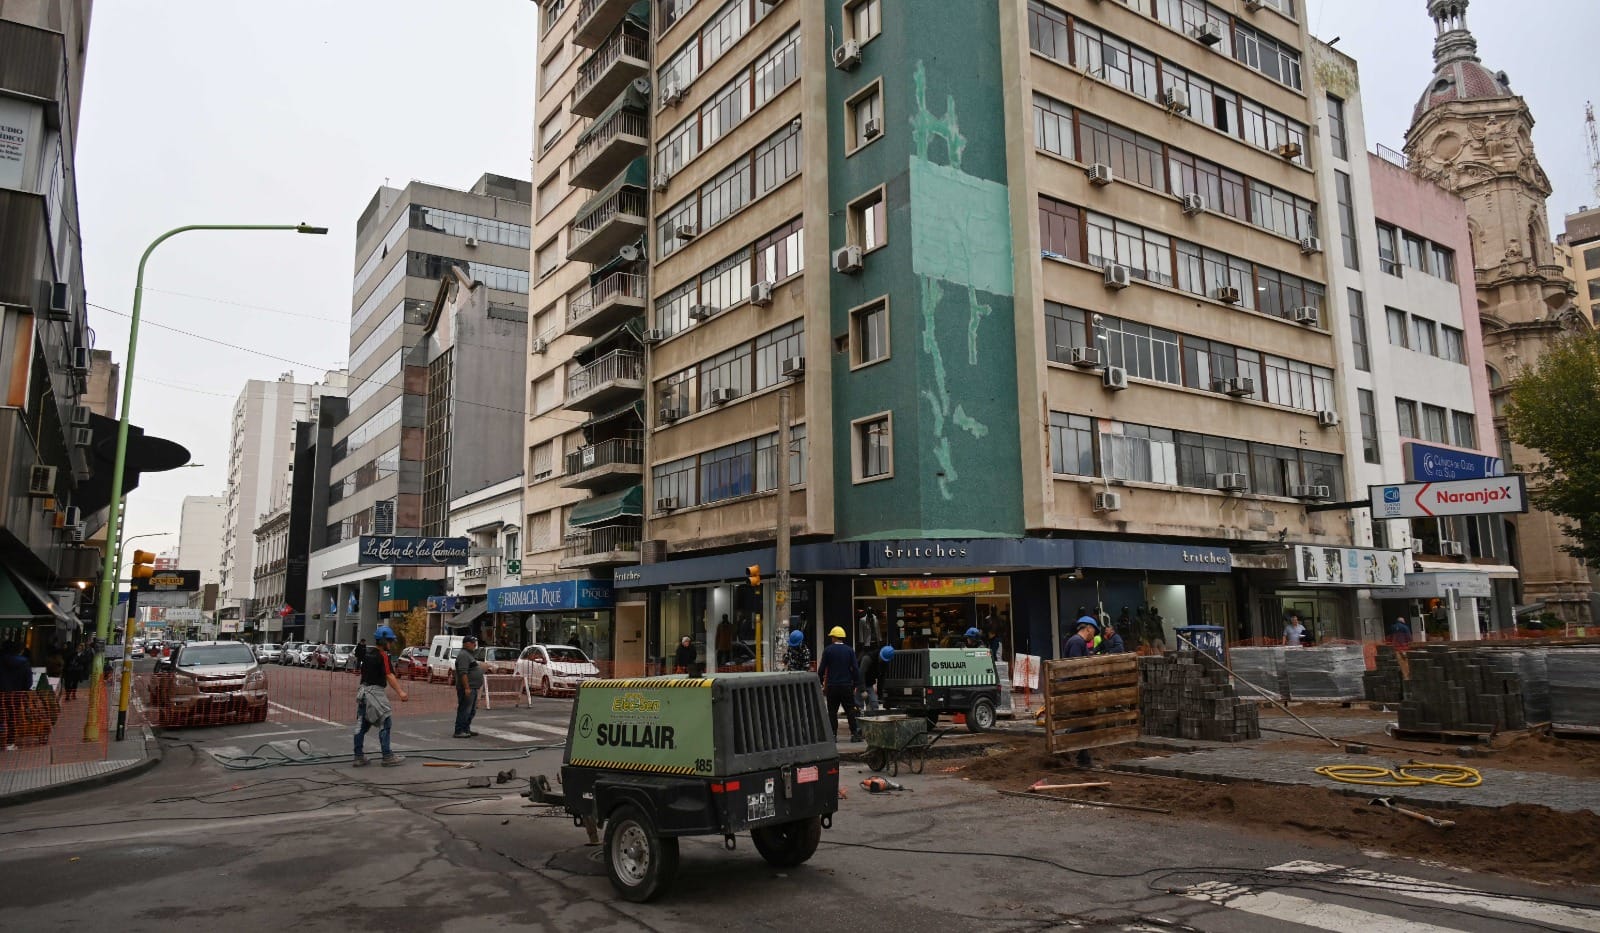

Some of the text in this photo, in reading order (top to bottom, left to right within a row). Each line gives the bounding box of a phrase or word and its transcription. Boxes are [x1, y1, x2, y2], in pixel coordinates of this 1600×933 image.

[362, 538, 378, 556] La
[379, 538, 401, 560] Casa
[402, 541, 414, 558] de
[431, 540, 467, 563] Camisas
[884, 543, 967, 558] britches
[1183, 550, 1227, 564] britches
[614, 569, 641, 582] britches
[504, 587, 562, 607] FARMACIA PIQUÉ
[940, 661, 967, 669] SULLAIR
[596, 722, 675, 750] SULLAIR
[694, 758, 712, 773] 185
